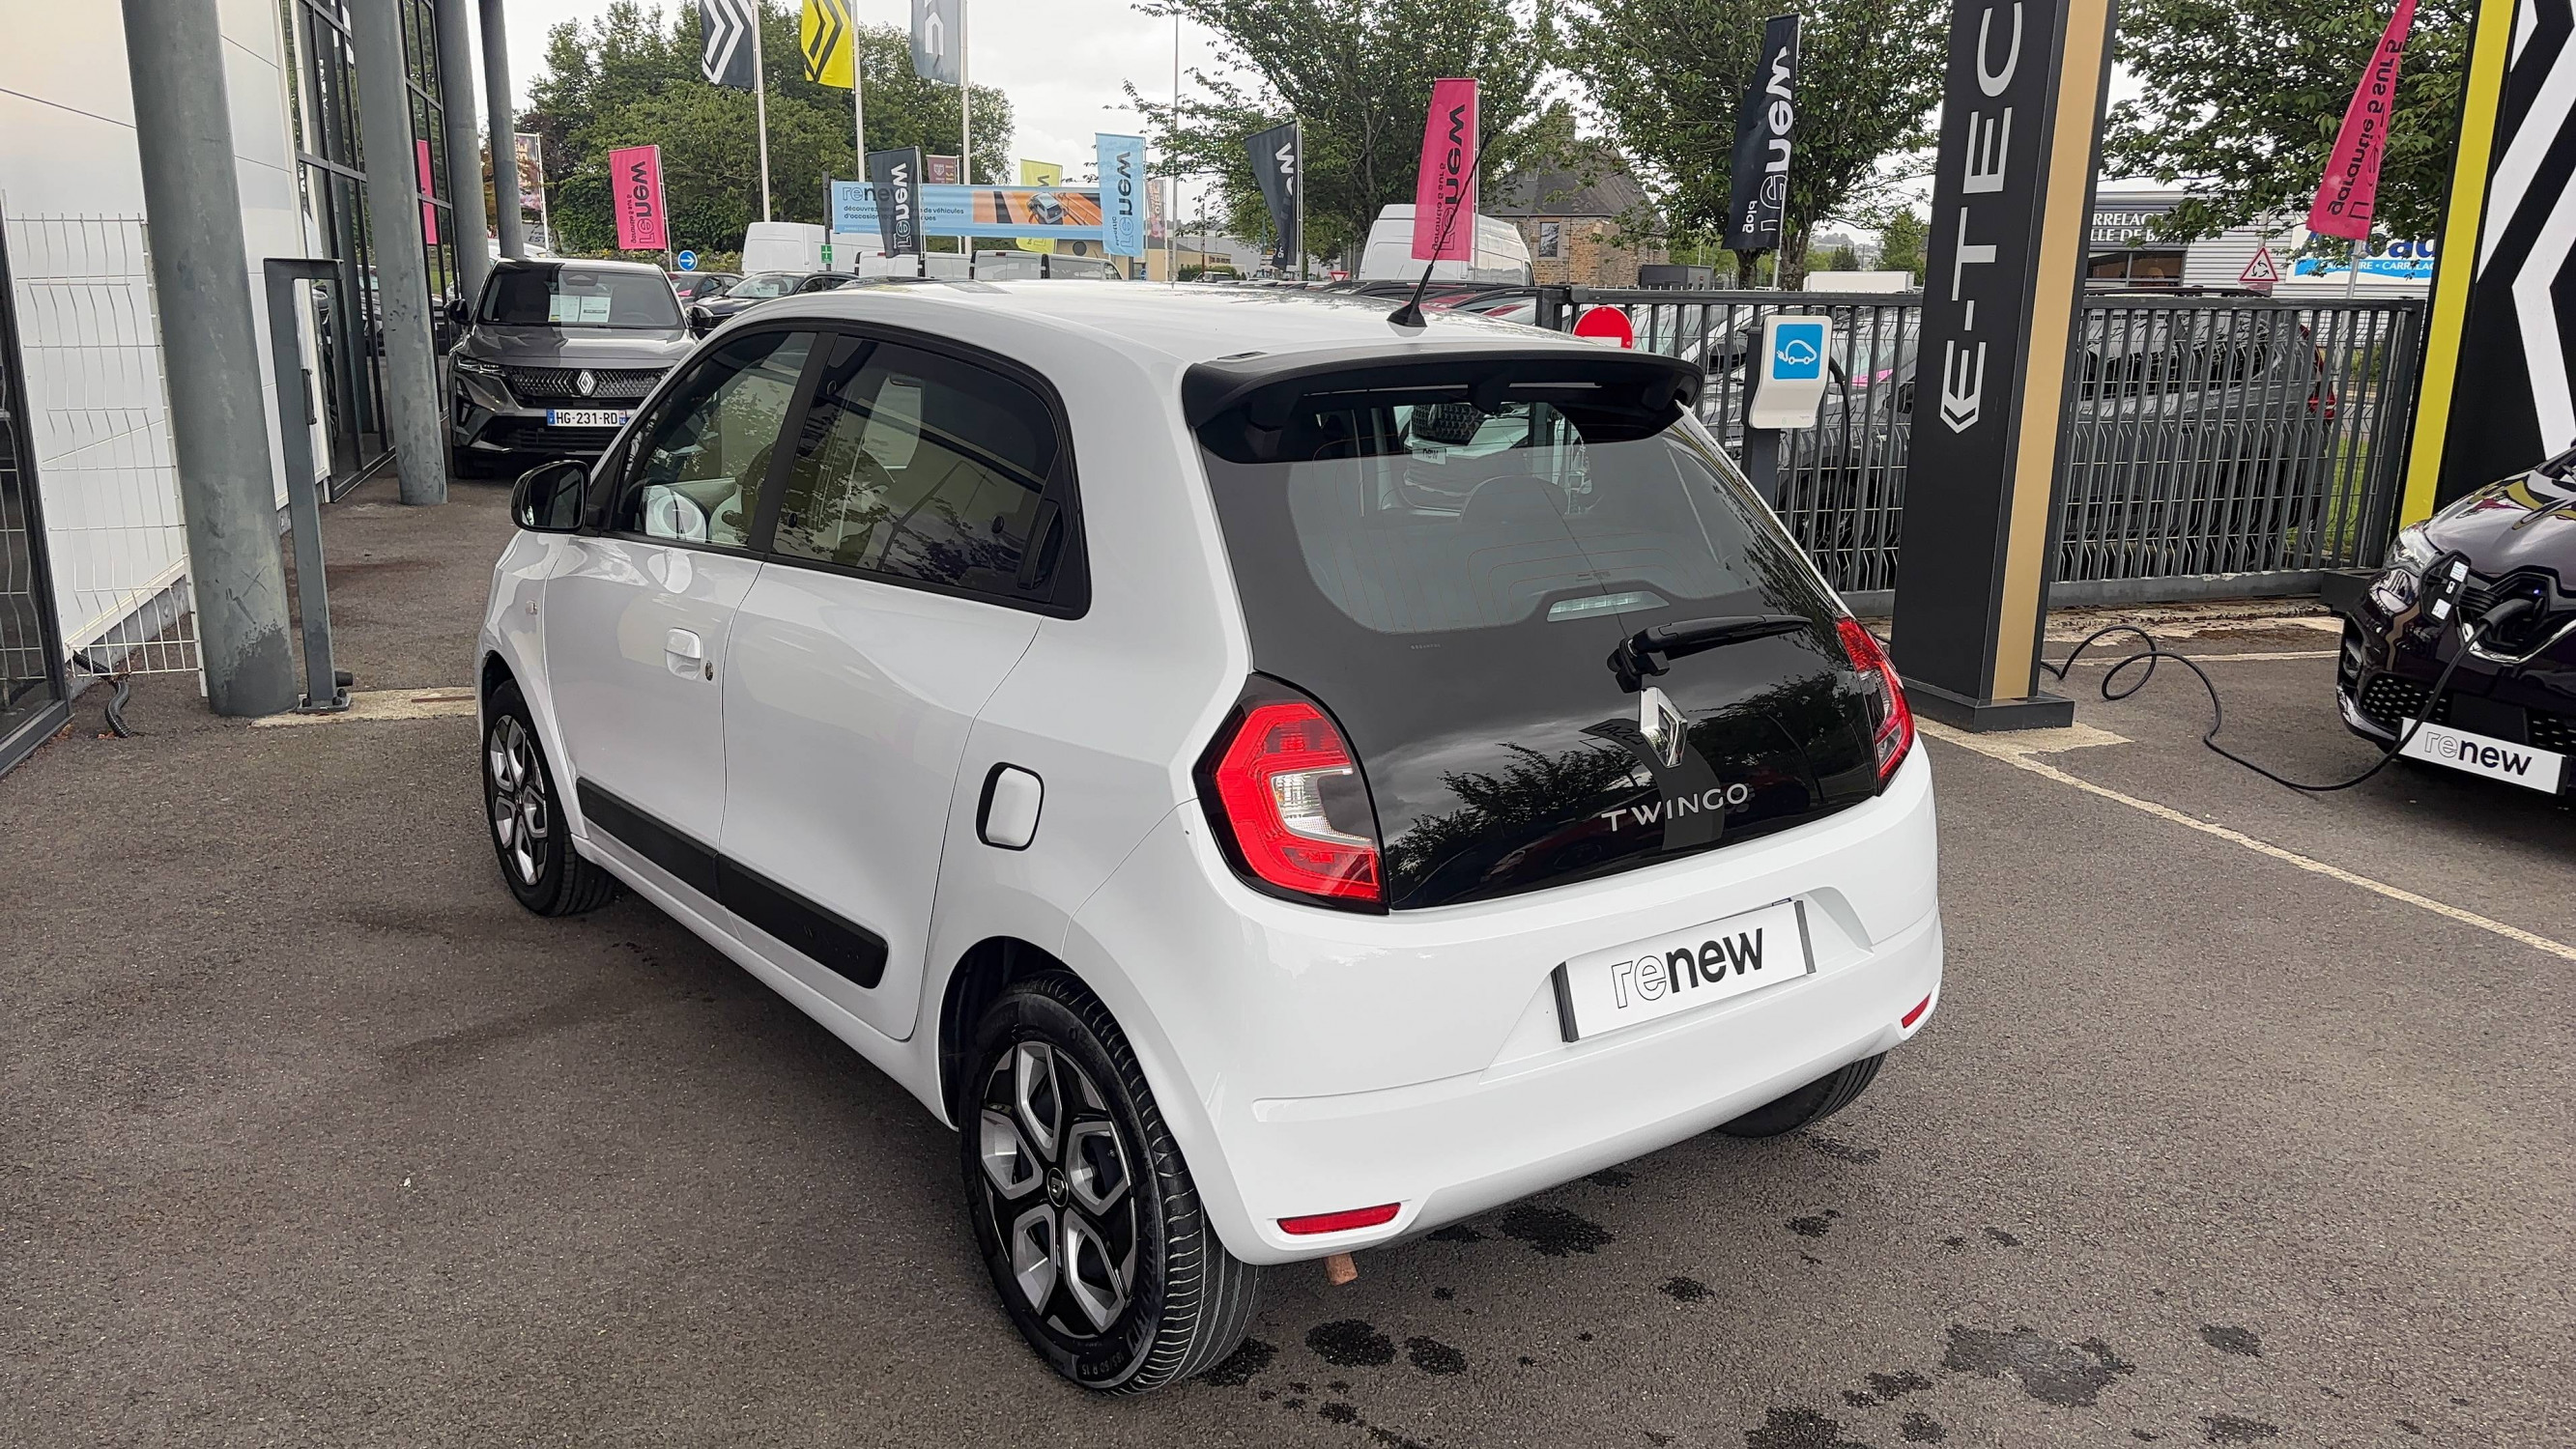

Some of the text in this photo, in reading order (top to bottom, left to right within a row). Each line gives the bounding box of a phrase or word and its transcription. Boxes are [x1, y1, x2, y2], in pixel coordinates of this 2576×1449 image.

[556, 412, 618, 425] HG-231-RD
[2424, 730, 2533, 776] renew
[1601, 783, 1749, 833] TWINGO
[1612, 927, 1763, 1009] renew
